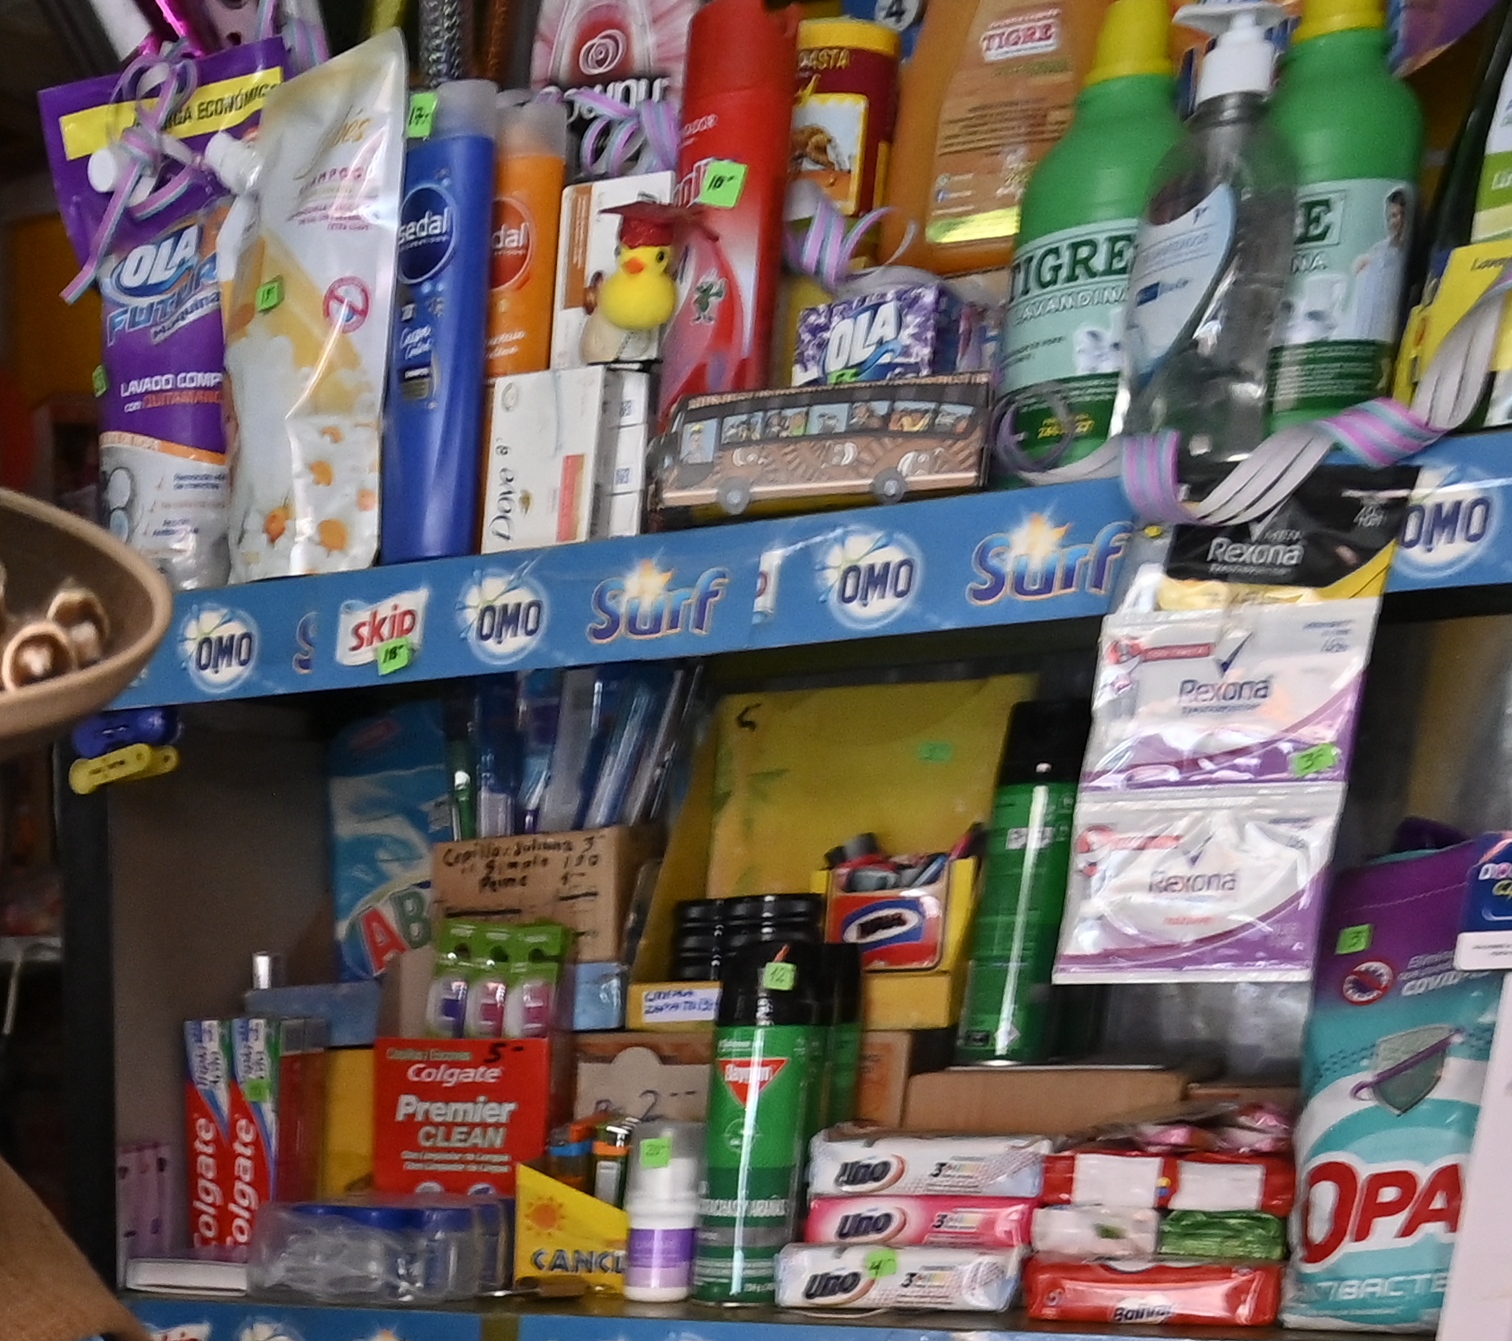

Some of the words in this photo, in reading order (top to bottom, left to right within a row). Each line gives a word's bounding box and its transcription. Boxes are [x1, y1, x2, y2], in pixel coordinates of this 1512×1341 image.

[981, 24, 1059, 59] TIGRE
[398, 208, 451, 243] sedal
[490, 222, 528, 249] dal
[121, 225, 198, 288] OLA
[828, 300, 902, 370] OLA
[121, 376, 175, 397] LAVADO
[177, 372, 223, 393] COMP
[491, 466, 516, 542] Dove
[1401, 496, 1492, 552] OMO
[1207, 536, 1304, 570] Rexona
[195, 631, 254, 673] OMO
[477, 599, 543, 641] OMO
[588, 567, 730, 644] Surf
[837, 557, 915, 607] OMO
[968, 518, 1133, 607] Surf
[1180, 676, 1271, 705] Rexona
[407, 1063, 504, 1087] Colgate
[395, 1094, 518, 1123] Premier
[418, 1126, 506, 1148] CLEAN
[837, 1158, 893, 1188] Uno
[836, 1211, 893, 1241] Uno
[1303, 1159, 1466, 1264] OPA
[804, 1270, 861, 1302] Uno
